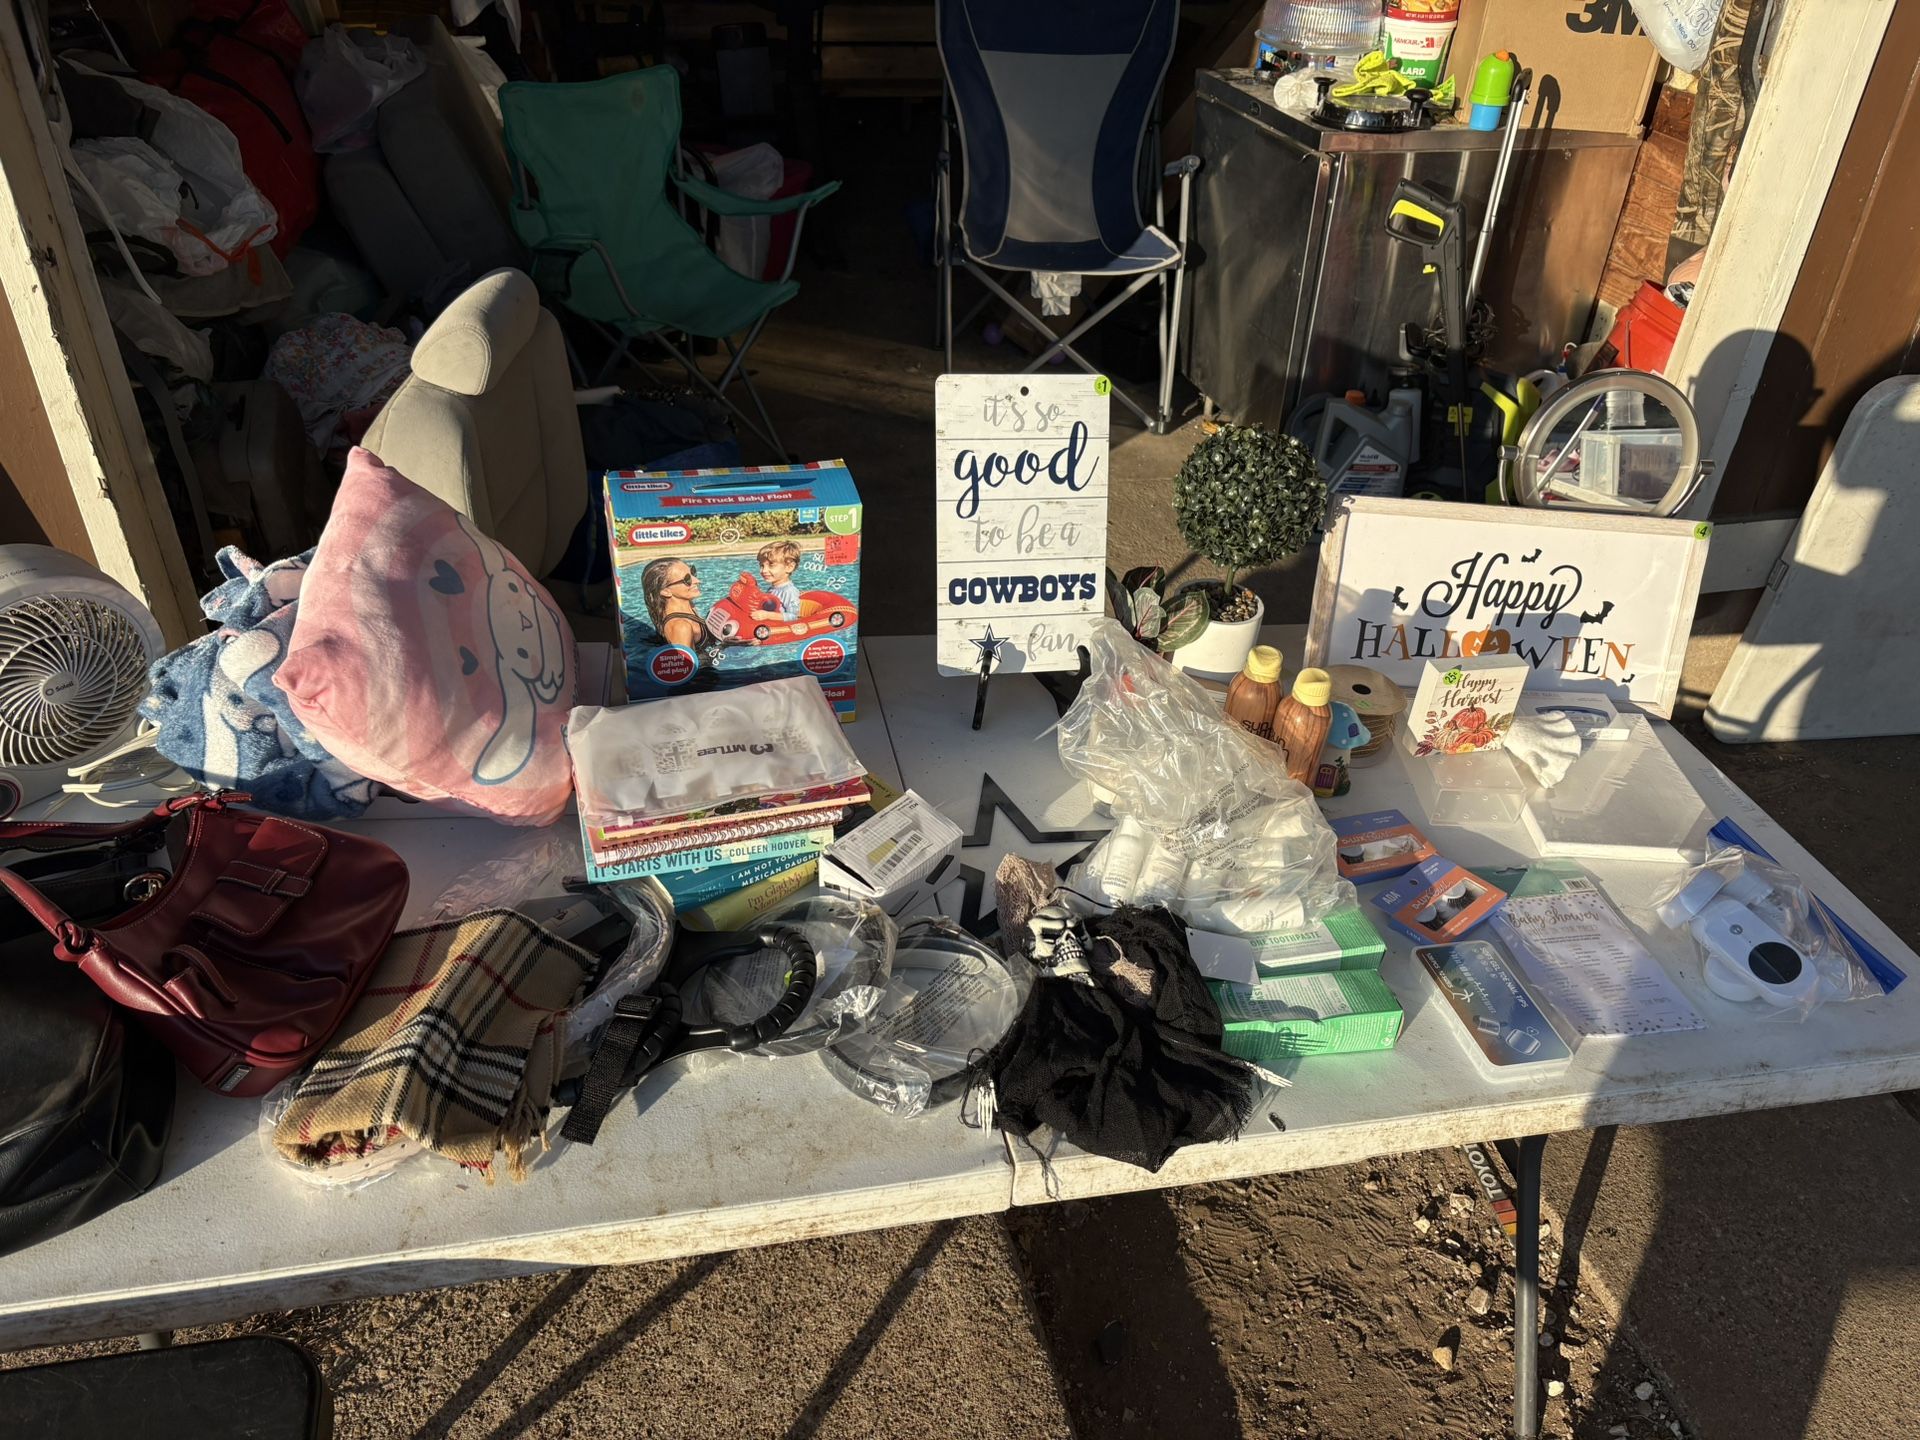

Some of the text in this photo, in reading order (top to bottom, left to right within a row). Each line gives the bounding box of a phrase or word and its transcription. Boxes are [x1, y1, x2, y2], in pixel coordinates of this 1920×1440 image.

[1400, 66, 1426, 76] LARD
[983, 394, 1066, 433] it's so
[954, 421, 1100, 519] good
[738, 494, 765, 503] Baby
[830, 507, 858, 529] STEP 1
[968, 504, 1082, 554] to be a
[634, 529, 685, 540] little tikes
[948, 572, 1097, 606] COWBOYS
[1421, 550, 1584, 630] Happy
[1026, 622, 1081, 660] fan
[1455, 673, 1497, 693] Happy
[1438, 688, 1514, 708] Harvest
[594, 838, 806, 878] IT STARTS WITH US COLLEEN HOOVER
[736, 869, 752, 880] AM
[754, 861, 772, 874] NOT
[742, 852, 820, 887] MEXICAN DAUGHT
[764, 880, 789, 900] Glad
[1508, 906, 1600, 928] Baby Shower
[1268, 931, 1322, 946] TOOTHPASTE
[1463, 1144, 1503, 1199] TOYOT
